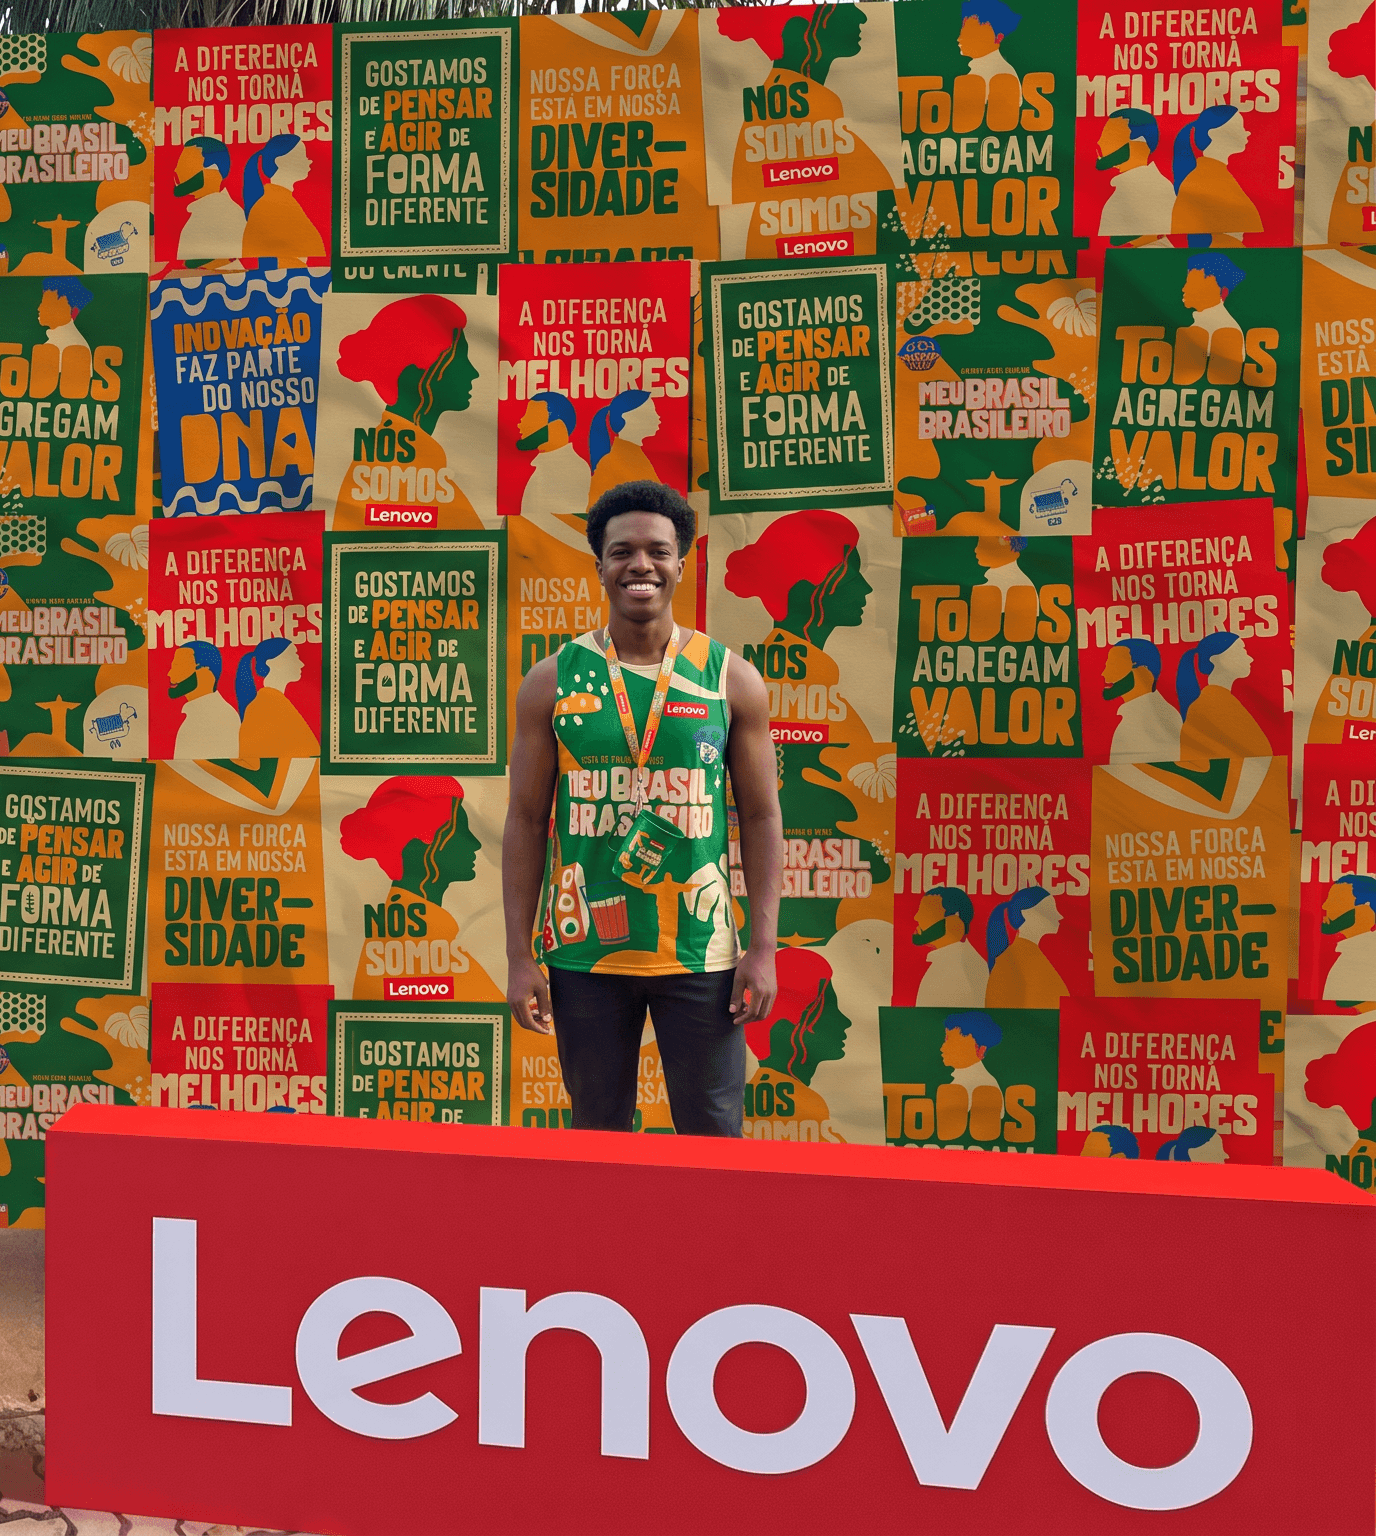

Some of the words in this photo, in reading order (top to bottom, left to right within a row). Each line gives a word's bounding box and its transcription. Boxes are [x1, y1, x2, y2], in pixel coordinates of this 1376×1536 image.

[1099, 12, 1115, 39] A
[1125, 7, 1258, 40] DIFERENÇA
[175, 47, 189, 72] A
[197, 42, 318, 74] DIFERENÇA
[365, 57, 487, 87] GOSTAMOS
[1114, 42, 1158, 70] NOS
[188, 76, 228, 102] NOS
[530, 66, 601, 94] NOSSA
[610, 63, 681, 94] FORÇA
[1077, 69, 1280, 117] MELHORES
[360, 96, 380, 116] DE
[383, 88, 492, 121] PENSAR
[584, 95, 612, 118] EM
[619, 92, 681, 117] NOSSA
[742, 74, 809, 122] NÓS
[33, 122, 127, 154] BRASIL
[154, 101, 333, 146] MELHORES
[379, 121, 441, 152] AGIR
[449, 128, 470, 148] DE
[745, 118, 855, 162] SOMOS
[366, 152, 484, 194] FORMA
[769, 163, 833, 182] Lenovo
[530, 168, 678, 218] SIDADE
[893, 176, 1060, 240] VALOR
[366, 197, 489, 226] DIFERENTE
[760, 195, 872, 236] SOMOS
[784, 239, 848, 256] Lenovo
[519, 301, 533, 327] A
[543, 298, 667, 327] DIFERENÇA
[738, 294, 863, 330] GOSTAMOS
[533, 331, 575, 356] NOS
[732, 337, 754, 357] DE
[757, 325, 870, 362] PENSAR
[176, 354, 218, 384] FAZ
[227, 346, 302, 380] PARTE
[499, 357, 688, 400] MELHORES
[740, 372, 750, 391] E
[755, 361, 820, 394] AGIR
[827, 366, 850, 386] DE
[203, 384, 232, 412] DO
[241, 376, 314, 409] NOSSO
[918, 381, 965, 407] MEU
[965, 377, 1070, 411] BRASIL
[1112, 388, 1274, 429] AGREGAM
[742, 390, 867, 437] FORMA
[918, 409, 1071, 441] BRASILEIRO
[181, 407, 314, 484] DNA
[354, 419, 416, 463] NÓS
[744, 434, 872, 469] DIFERENTE
[1109, 430, 1279, 494] VALOR
[352, 466, 455, 504] SOMOS
[370, 508, 432, 523] Lenovo
[165, 551, 178, 576] A
[187, 547, 306, 577] DIFERENÇA
[1095, 546, 1110, 572] A
[1119, 536, 1252, 571] DIFERENÇA
[178, 580, 218, 605] NOS
[355, 571, 475, 598] GOSTAMOS
[521, 577, 590, 602] NOSSA
[1112, 575, 1156, 602] NOS
[33, 606, 125, 637] BRASIL
[147, 603, 323, 650] MELHORES
[348, 606, 368, 624] DE
[372, 599, 479, 631] PENSAR
[521, 607, 567, 629] ESTA
[575, 607, 601, 629] EM
[1077, 595, 1279, 649] MELHORES
[354, 639, 365, 658] E
[369, 630, 431, 662] AGIR
[438, 639, 458, 658] DE
[912, 644, 1069, 684] AGREGAM
[355, 662, 473, 703] FORMA
[354, 706, 477, 734] DIFERENTE
[667, 705, 705, 715] Lenovo
[910, 686, 1076, 751] VALOR
[611, 766, 713, 804] BRASIL
[1325, 780, 1340, 806] A
[916, 793, 931, 819] A
[940, 793, 1069, 825] DIFERENÇA
[20, 823, 124, 859] PENSAR
[164, 823, 230, 847] NOSSA
[240, 823, 306, 851] FORÇA
[929, 825, 972, 850] NOS
[1106, 831, 1181, 858] NOSSA
[1191, 826, 1266, 856] FORÇA
[2, 859, 11, 876] E
[16, 854, 77, 885] AGIR
[164, 849, 209, 872] ESTA
[216, 849, 242, 871] EM
[247, 849, 306, 872] NOSSA
[894, 853, 1089, 896] MELHORES
[1108, 858, 1156, 884] ESTA
[1166, 855, 1194, 881] EM
[1200, 856, 1266, 880] NOSSA
[0, 883, 112, 929] FORMA
[364, 893, 427, 938] NÓS
[165, 923, 305, 968] SIDADE
[366, 939, 469, 976] SOMOS
[1113, 931, 1269, 984] SIDADE
[389, 981, 448, 996] Lenovo
[172, 1016, 186, 1041] A
[194, 1016, 312, 1047] DIFERENÇA
[1081, 1031, 1096, 1058] A
[1105, 1032, 1235, 1065] DIFERENÇA
[185, 1046, 224, 1071] NOS
[359, 1041, 480, 1068] GOSTAMOS
[352, 1074, 373, 1093] DE
[377, 1069, 485, 1101] PENSAR
[1094, 1063, 1137, 1090] NOS
[151, 1072, 327, 1116] MELHORES
[441, 1109, 463, 1125] DE
[1058, 1091, 1258, 1136] MELHORES
[151, 1215, 1254, 1511] Lenovo
